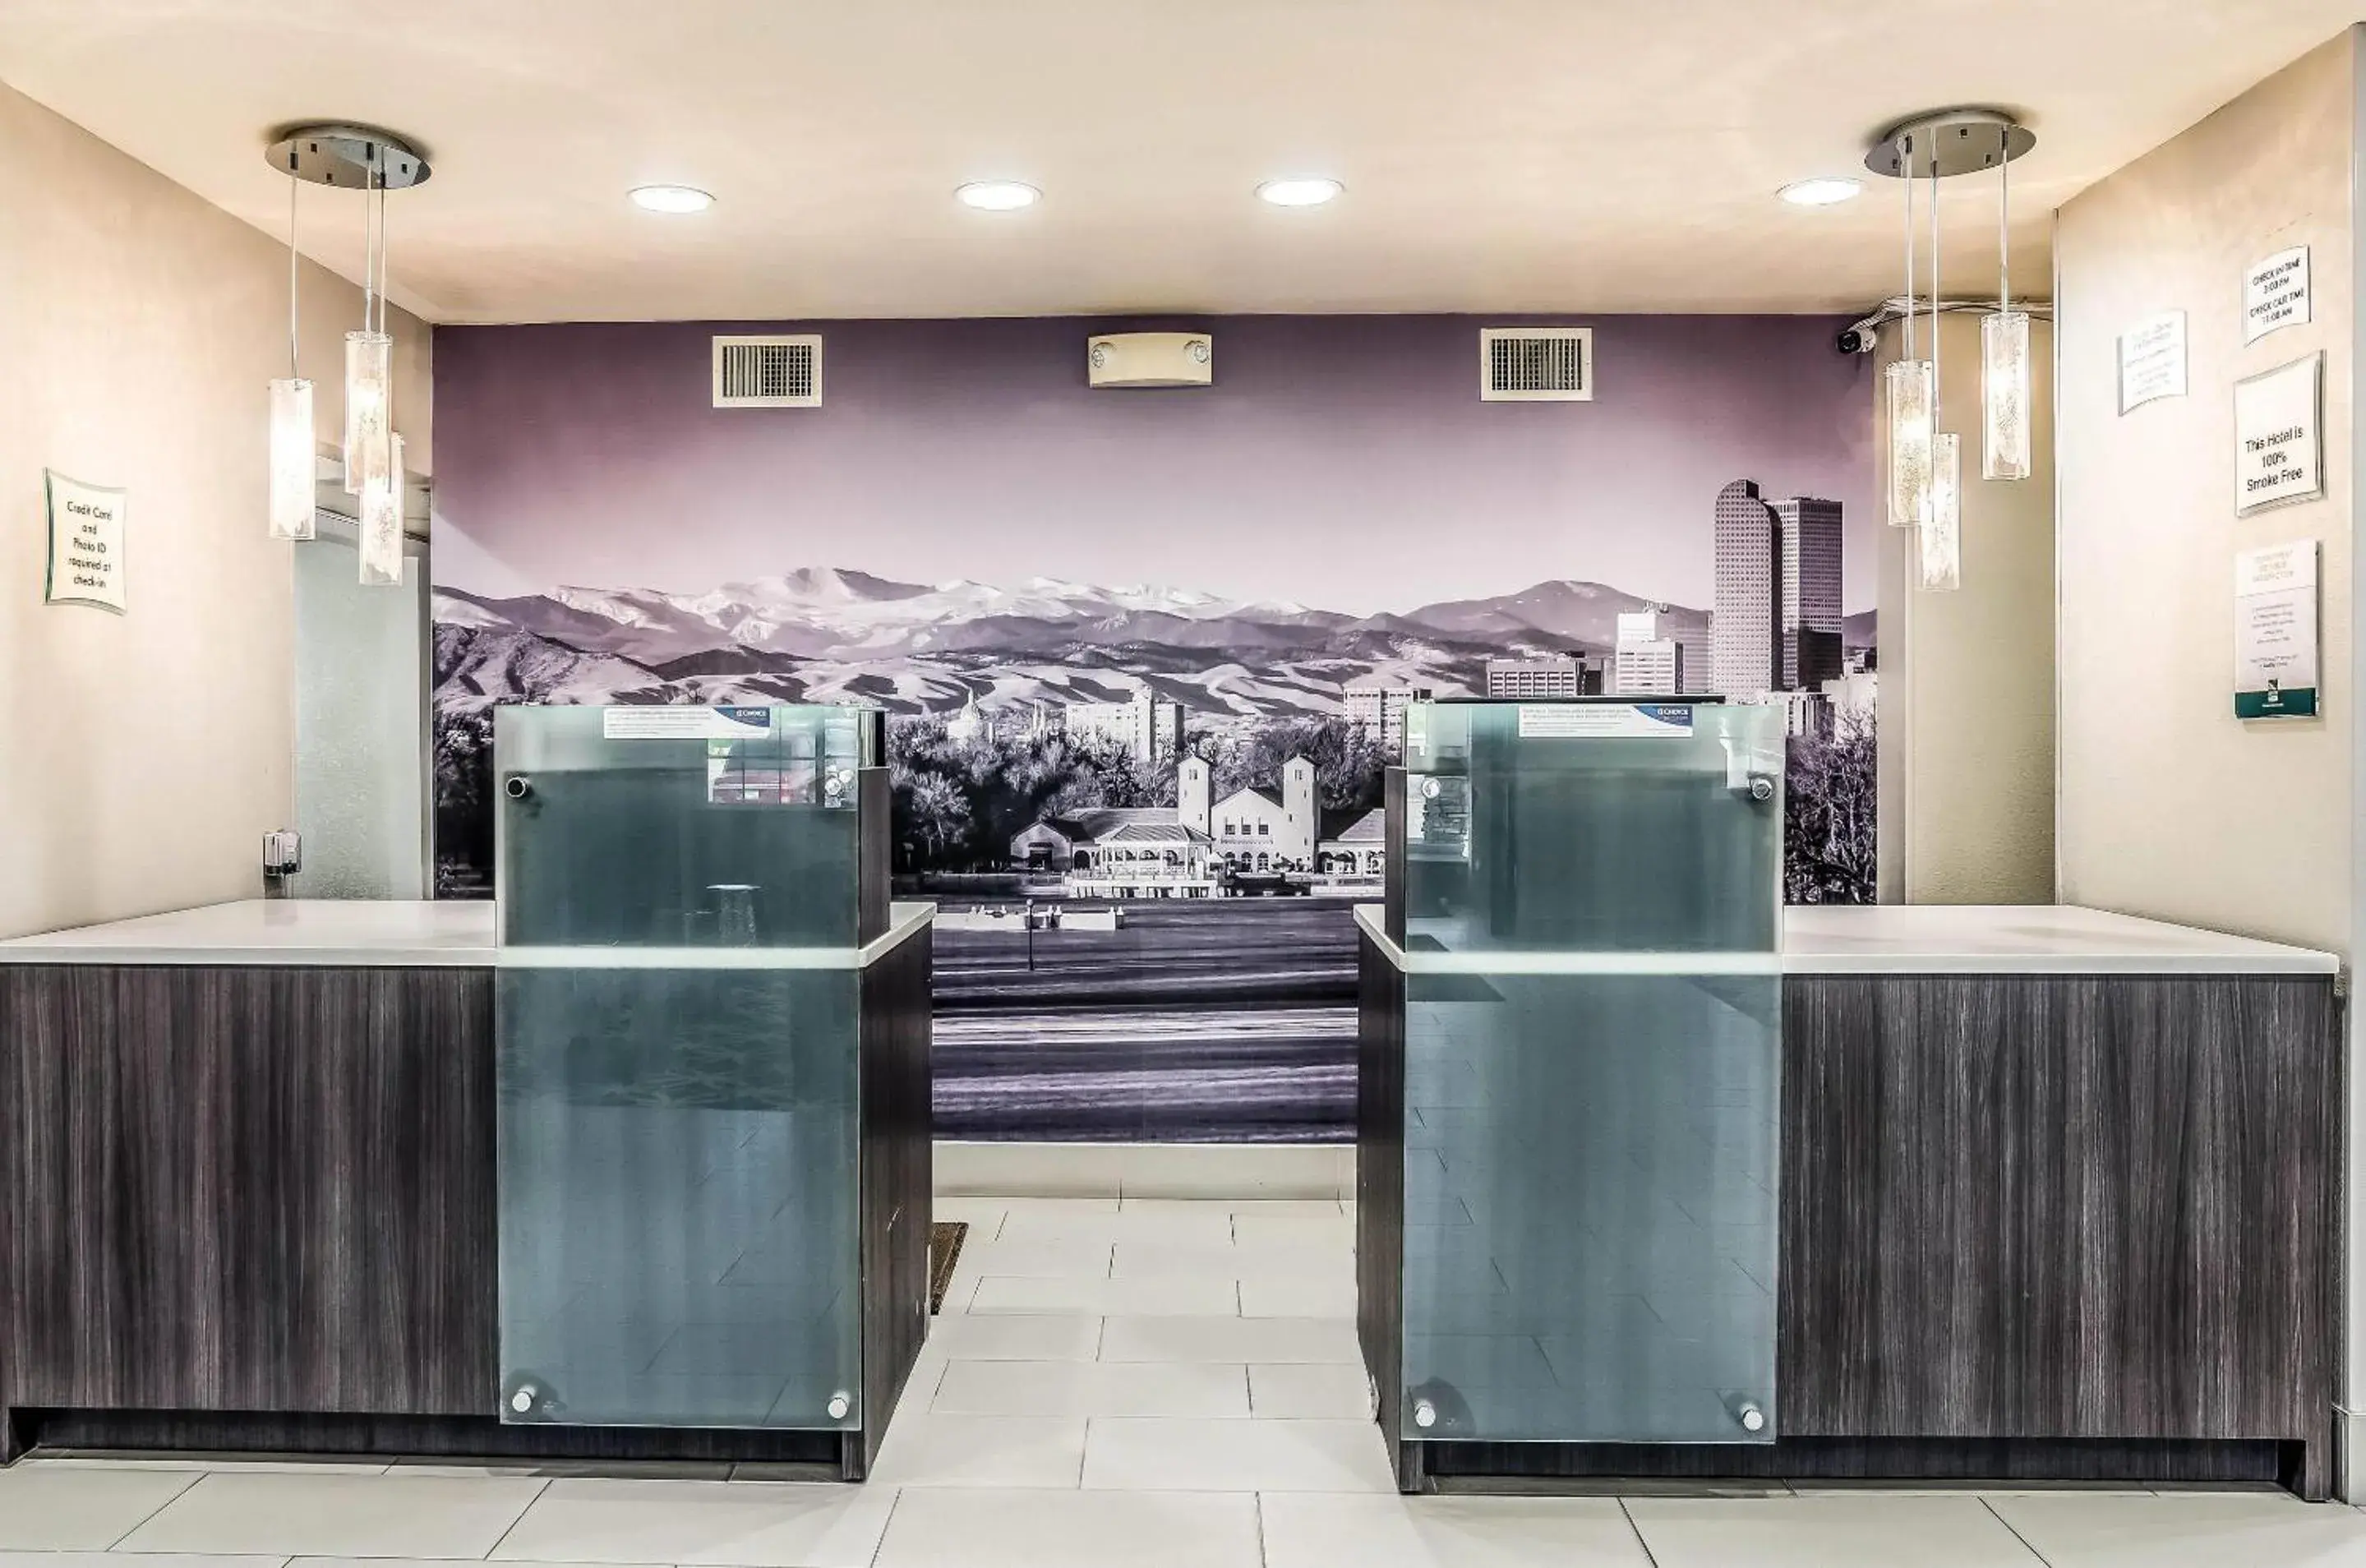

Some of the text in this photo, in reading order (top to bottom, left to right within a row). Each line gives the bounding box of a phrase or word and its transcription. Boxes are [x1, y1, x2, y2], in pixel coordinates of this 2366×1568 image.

[2250, 301, 2272, 318] CHECK
[2246, 426, 2304, 453] This Hotel is
[2262, 451, 2287, 468] 100%
[2247, 468, 2303, 491] Smoke Free
[67, 500, 113, 520] Credit Card
[82, 524, 97, 535] and
[73, 537, 107, 553] Photo ID
[68, 559, 111, 572] required at
[74, 575, 106, 588] check-in
